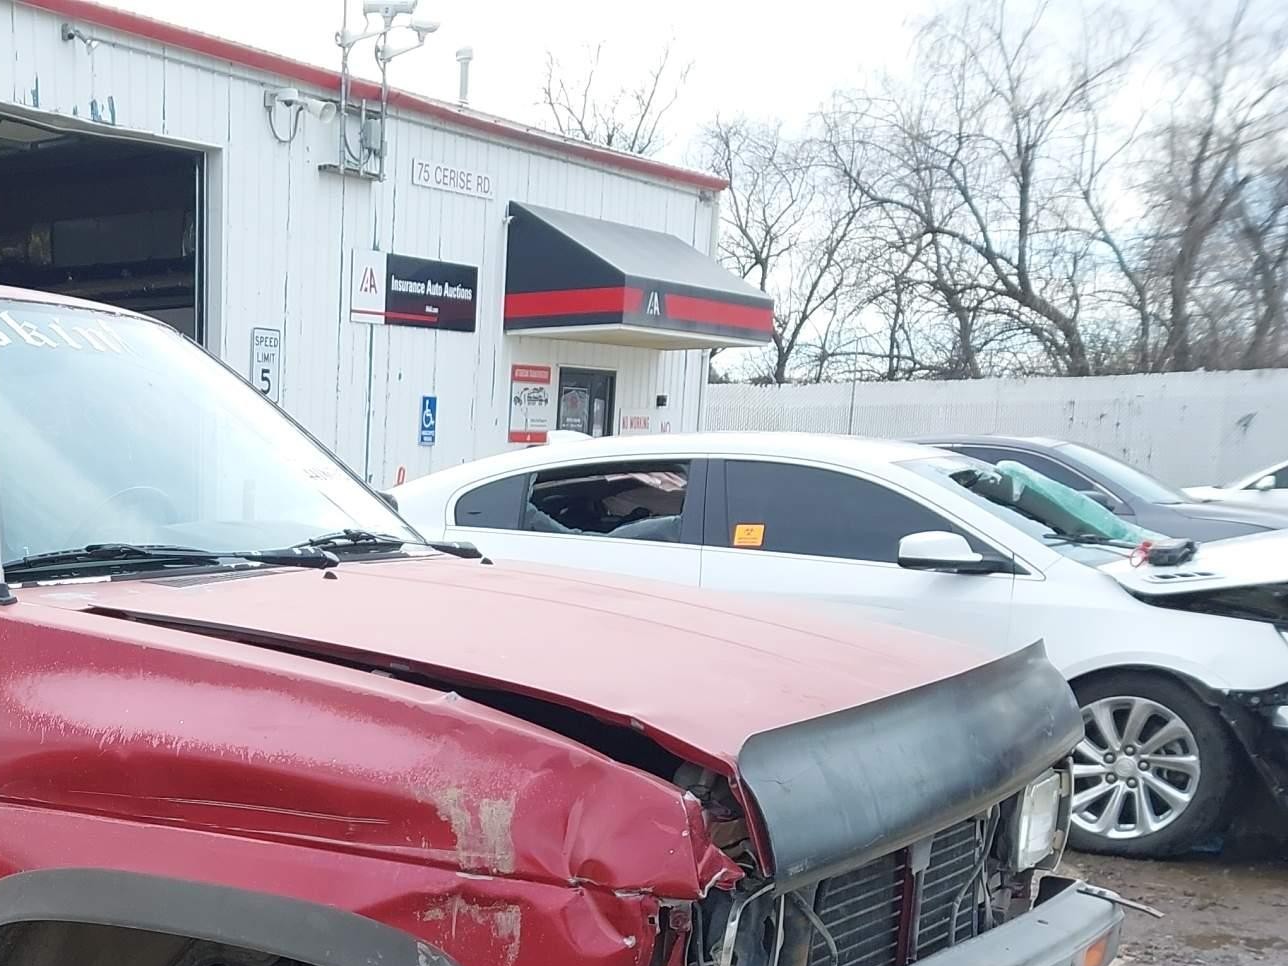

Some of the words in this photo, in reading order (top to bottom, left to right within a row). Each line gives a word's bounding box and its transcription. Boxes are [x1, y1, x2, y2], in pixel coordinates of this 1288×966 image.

[417, 162, 430, 182] 75
[434, 166, 472, 190] CERISE
[391, 275, 425, 295] Insurance
[426, 280, 442, 297] Auto
[443, 282, 472, 300] Auctions
[255, 335, 279, 348] SPEED
[256, 351, 275, 364] LIMIT
[260, 368, 271, 395] 5
